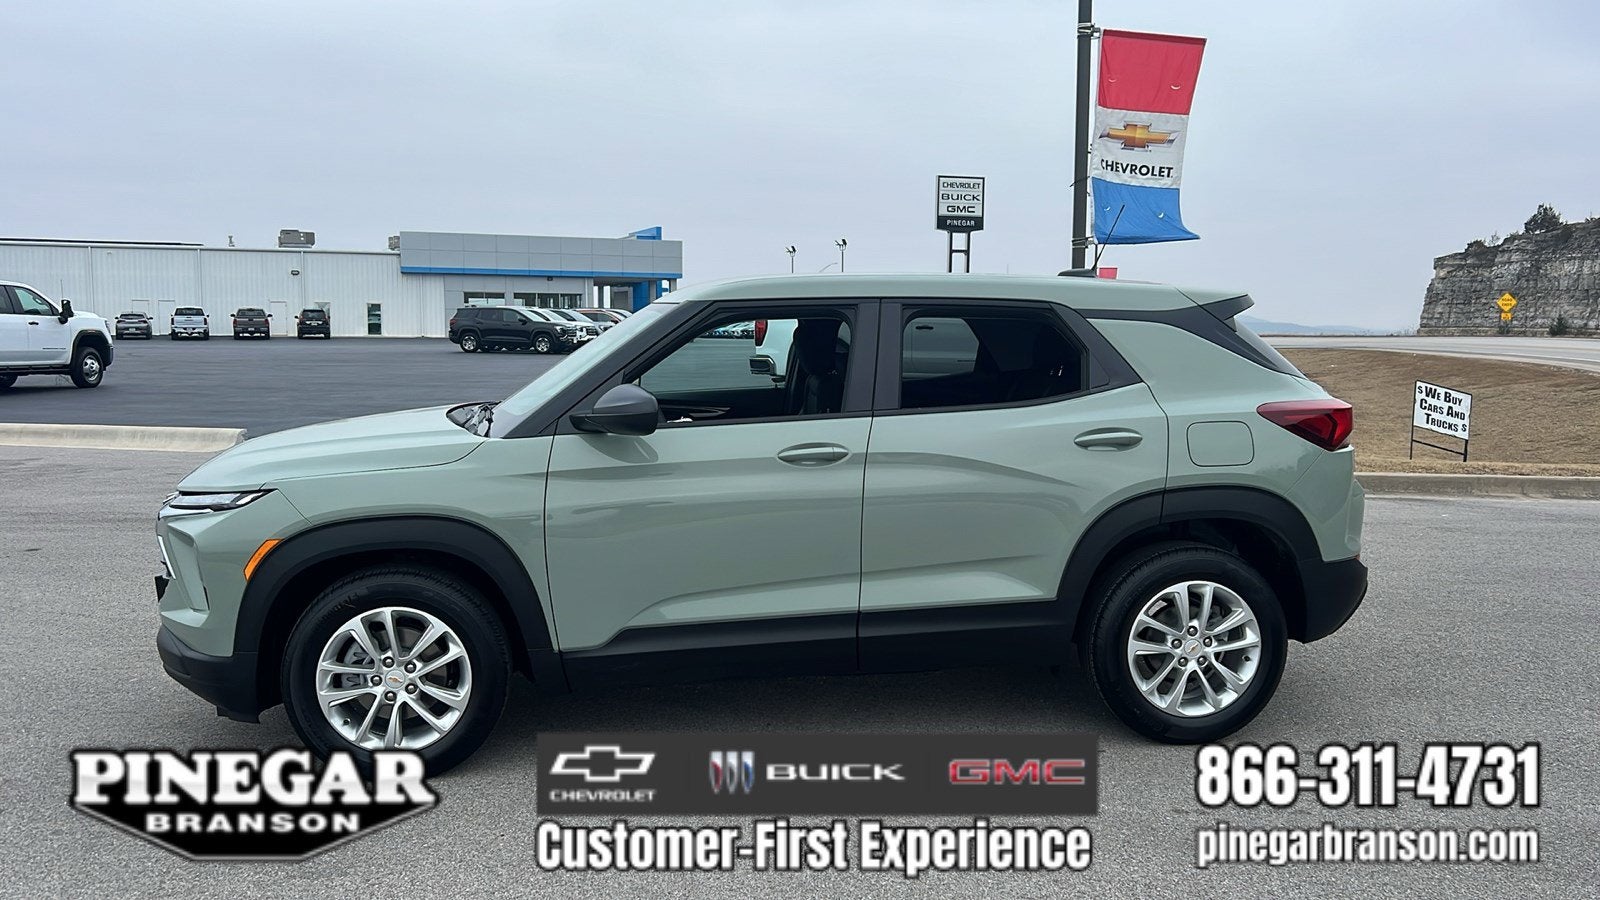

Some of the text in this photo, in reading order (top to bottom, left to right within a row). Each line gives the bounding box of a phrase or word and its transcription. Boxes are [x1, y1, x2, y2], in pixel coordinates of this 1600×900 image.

[1101, 158, 1173, 178] CHEVROLET
[942, 181, 981, 189] CHEVROLET
[941, 193, 981, 201] BUICK
[946, 205, 976, 213] GMC
[946, 219, 975, 227] PINEGAR
[1425, 386, 1441, 400] WE
[1444, 391, 1462, 406] BUY
[1420, 398, 1466, 420] CARS AND
[1425, 412, 1459, 432] TRUCKS
